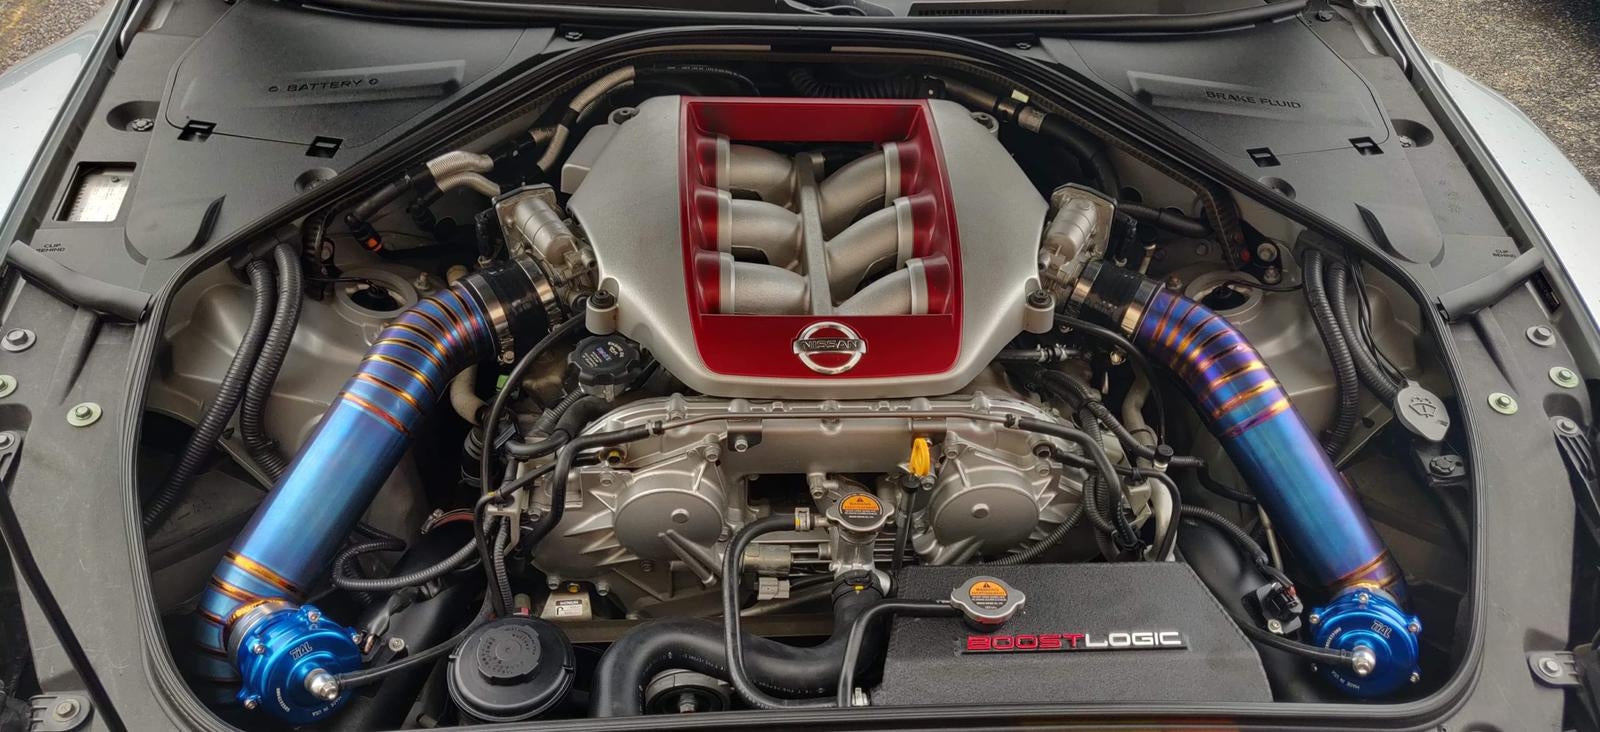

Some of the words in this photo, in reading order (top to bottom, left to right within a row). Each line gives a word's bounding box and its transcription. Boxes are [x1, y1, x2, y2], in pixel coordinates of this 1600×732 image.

[287, 79, 362, 92] BATTERY
[1206, 90, 1257, 104] BRAKE
[1260, 97, 1302, 109] FLUID
[801, 340, 858, 350] NISSAN
